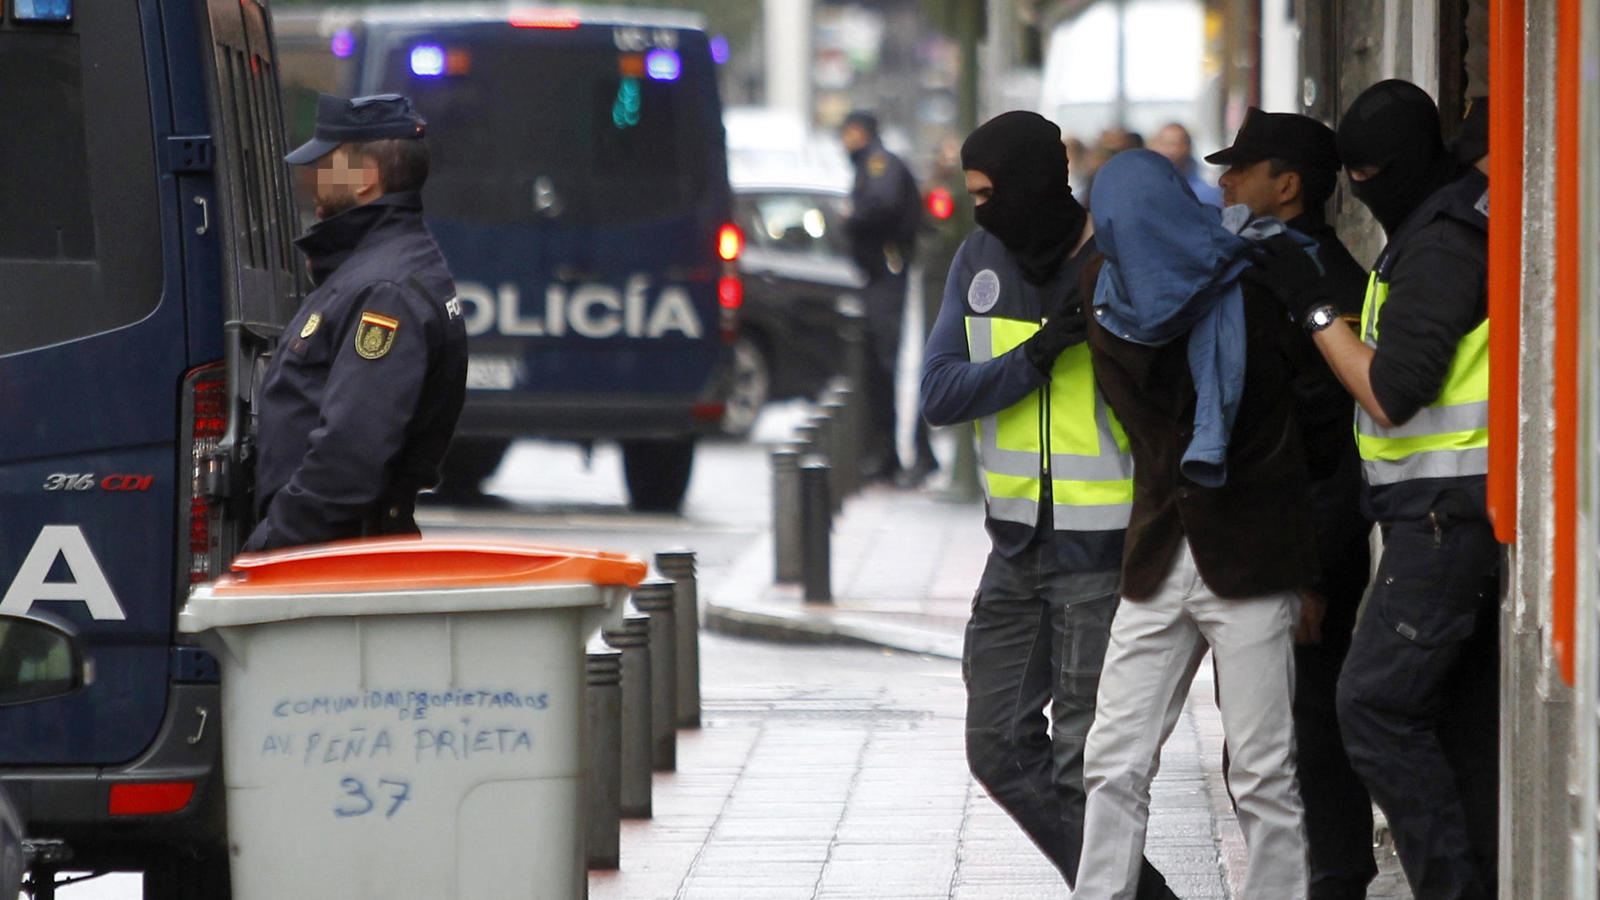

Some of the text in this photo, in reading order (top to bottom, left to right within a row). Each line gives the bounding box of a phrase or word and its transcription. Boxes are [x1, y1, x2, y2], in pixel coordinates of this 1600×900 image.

[455, 273, 701, 338] OLICÍA
[43, 473, 154, 491] 316 CDI
[399, 706, 427, 720] DE
[304, 727, 393, 766] PEÑA
[415, 716, 532, 762] PRIETA
[333, 777, 409, 818] 37
